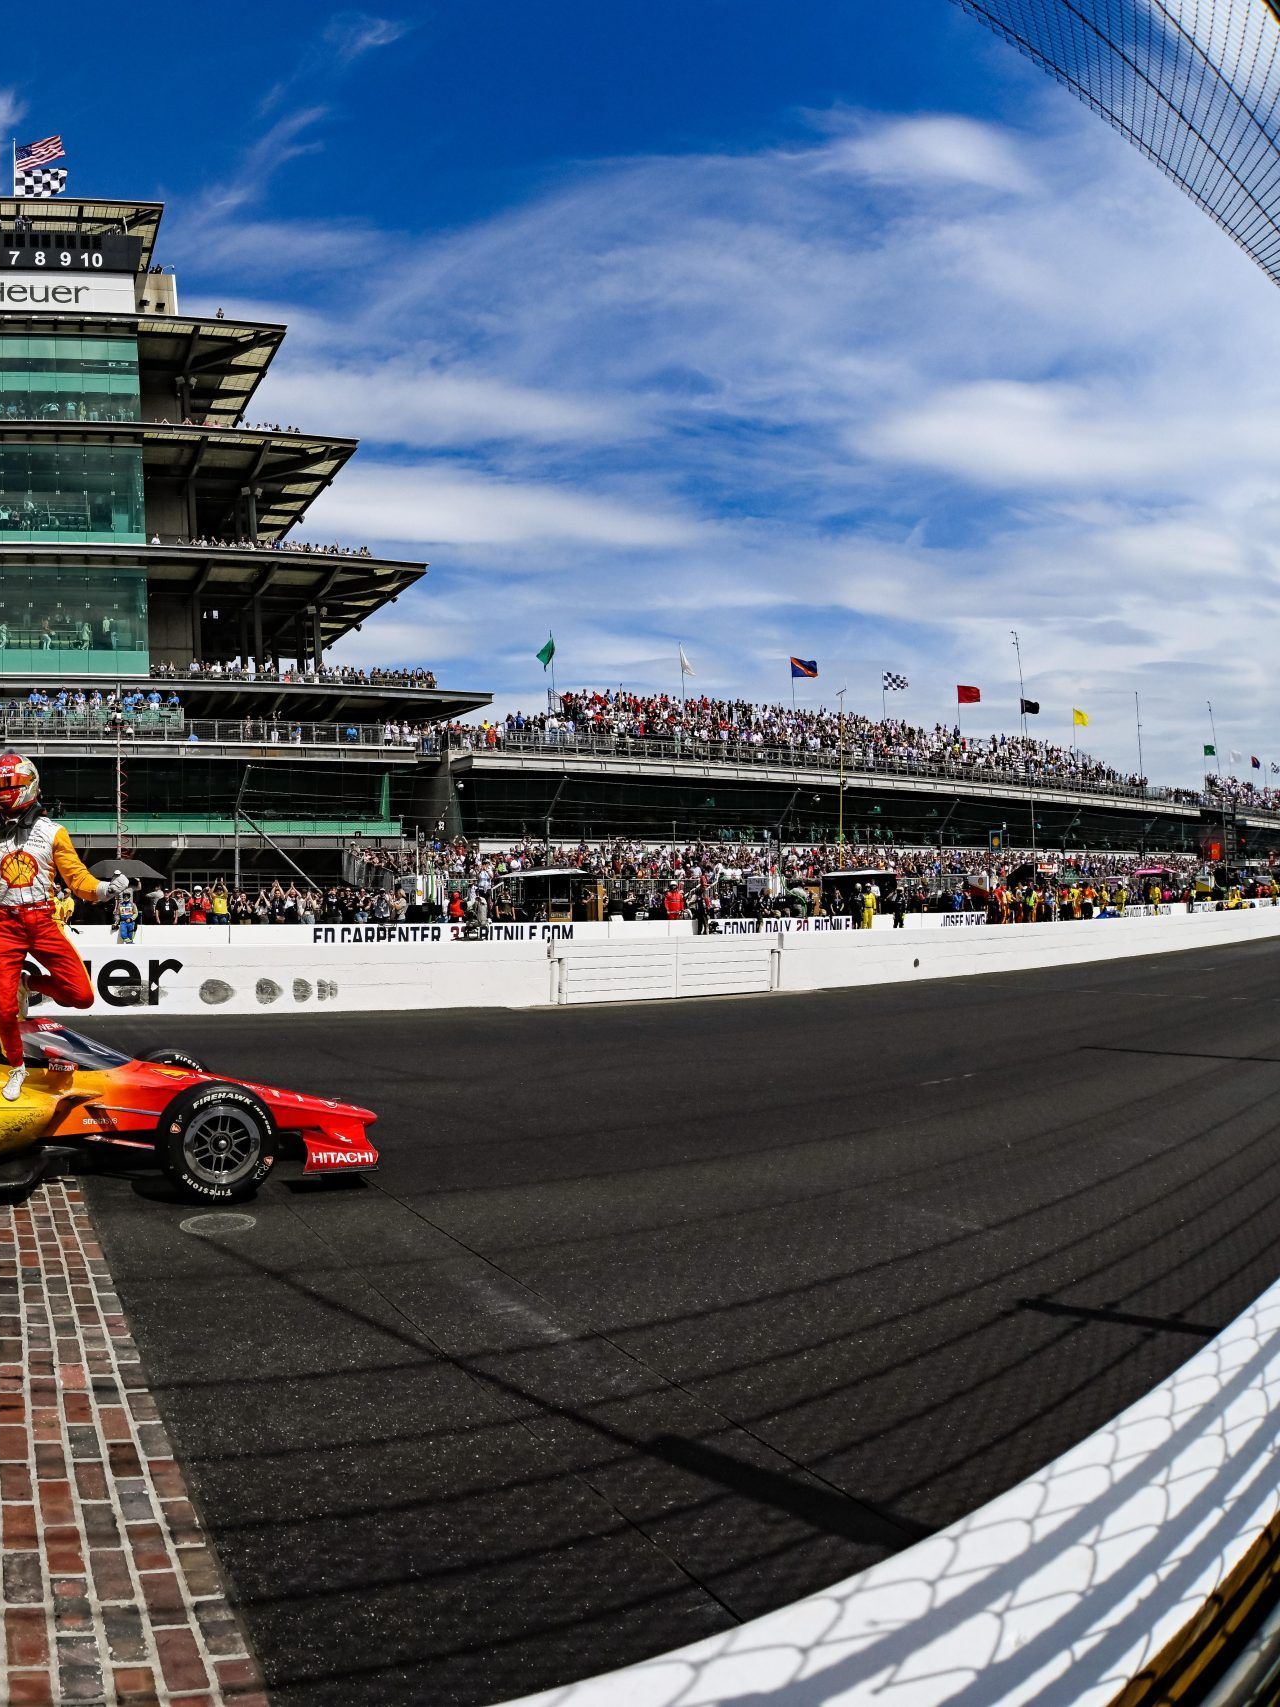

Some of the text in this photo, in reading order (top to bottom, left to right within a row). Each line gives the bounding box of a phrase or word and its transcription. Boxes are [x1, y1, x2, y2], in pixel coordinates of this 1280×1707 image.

[9, 251, 20, 264] 7
[34, 251, 46, 265] 8
[60, 252, 71, 266] 9
[80, 252, 103, 267] 10
[341, 927, 441, 943] CARPENTER
[724, 920, 758, 934] CONO
[175, 1055, 202, 1072] Firesto
[192, 1092, 253, 1109] FIREHAWK
[312, 1152, 373, 1163] HITACHI
[181, 1173, 232, 1197] Firestone
